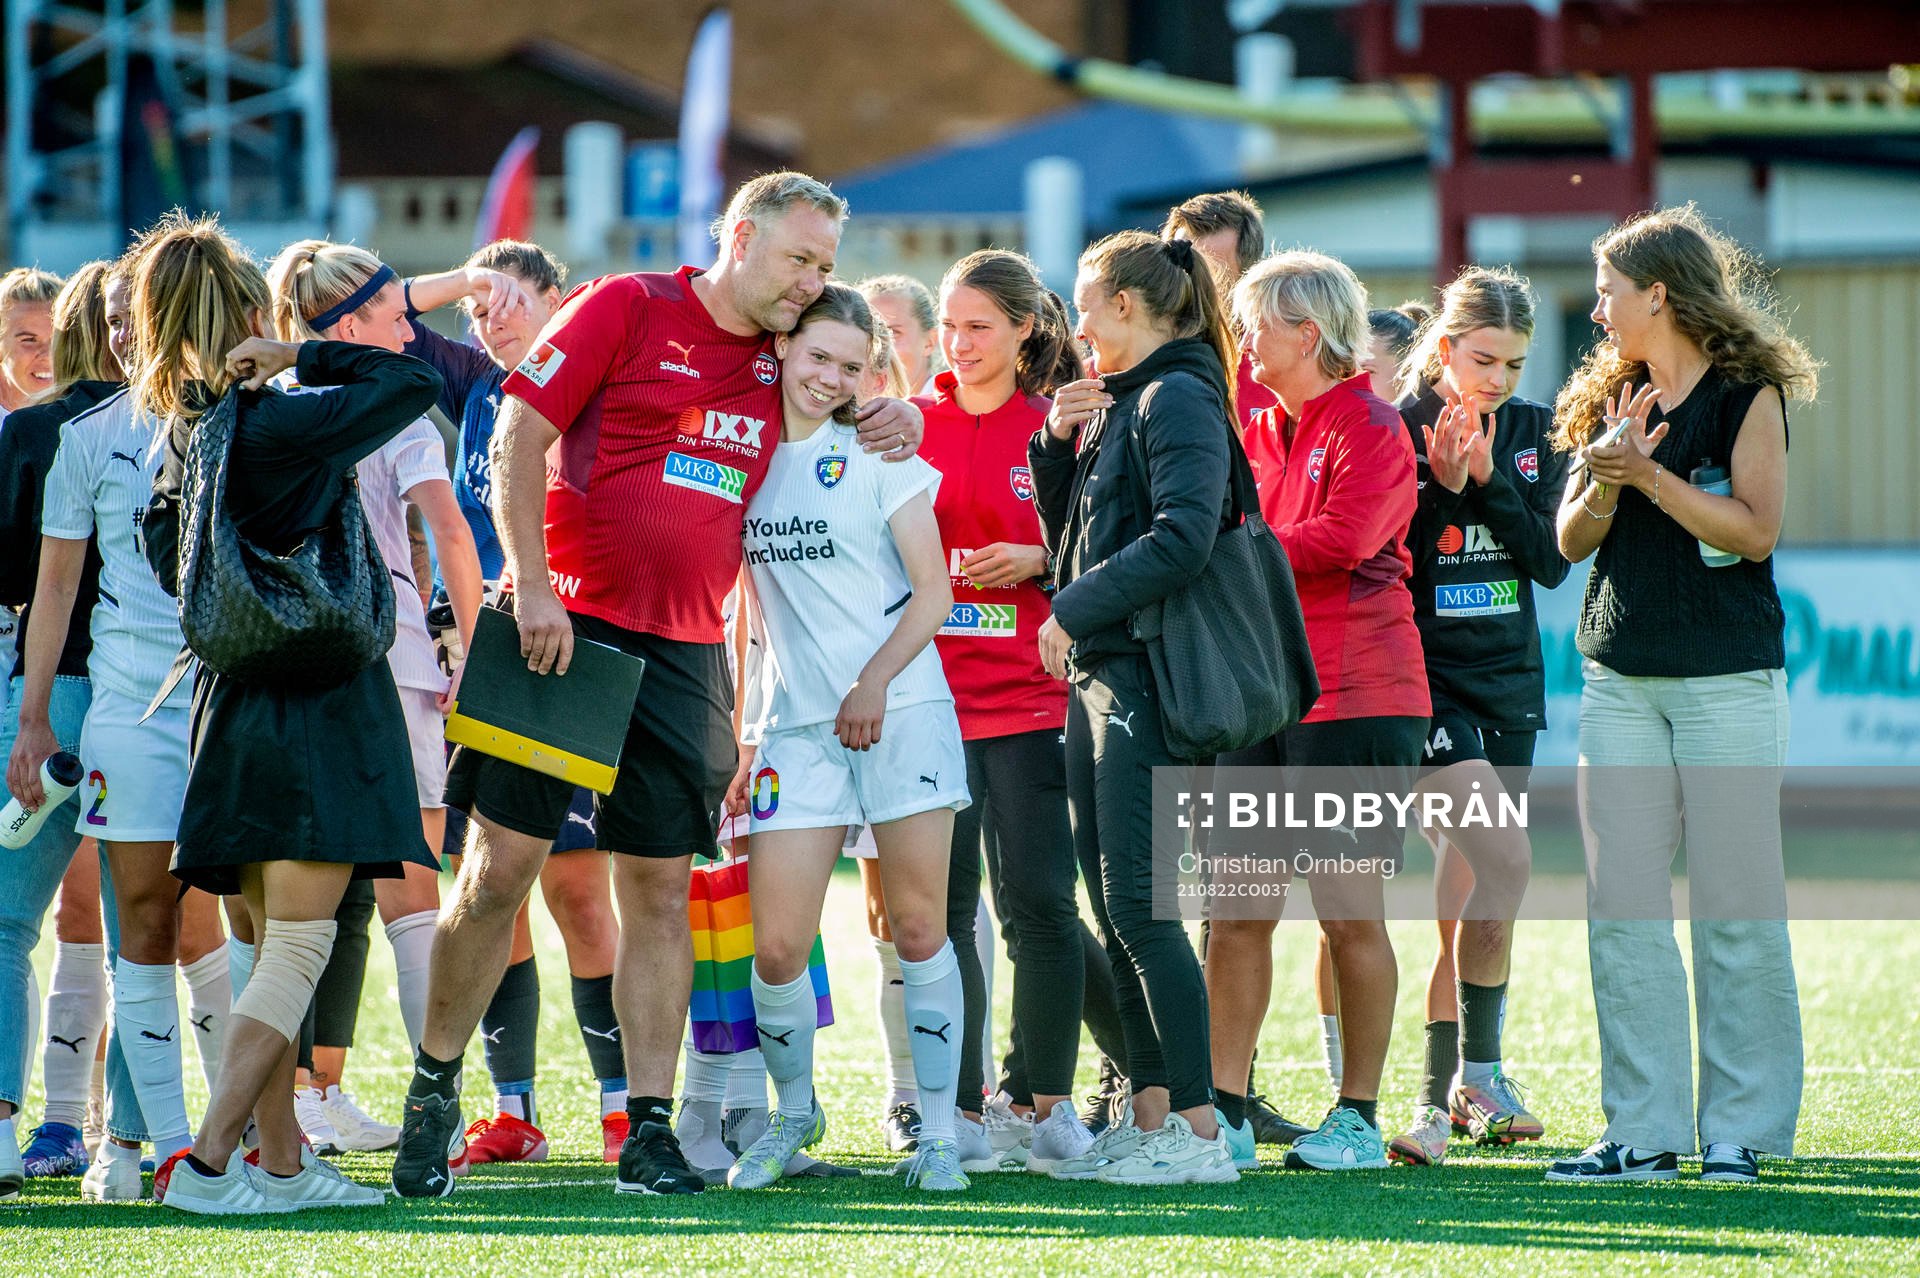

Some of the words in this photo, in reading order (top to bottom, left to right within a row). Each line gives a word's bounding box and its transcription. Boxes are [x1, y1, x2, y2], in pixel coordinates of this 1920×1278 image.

[659, 361, 700, 379] stadium
[755, 360, 775, 372] FCR
[703, 410, 766, 448] IXX
[676, 434, 697, 447] DIN
[701, 438, 759, 459] IT-PARTNER
[672, 457, 715, 481] MKB
[740, 515, 828, 540] #YouAre
[1464, 524, 1505, 553] IX
[743, 538, 836, 566] Included
[1438, 555, 1460, 565] DIN
[1443, 587, 1487, 606] MKB
[944, 607, 973, 624] KB
[1424, 726, 1453, 759] 14
[86, 769, 108, 827] 2
